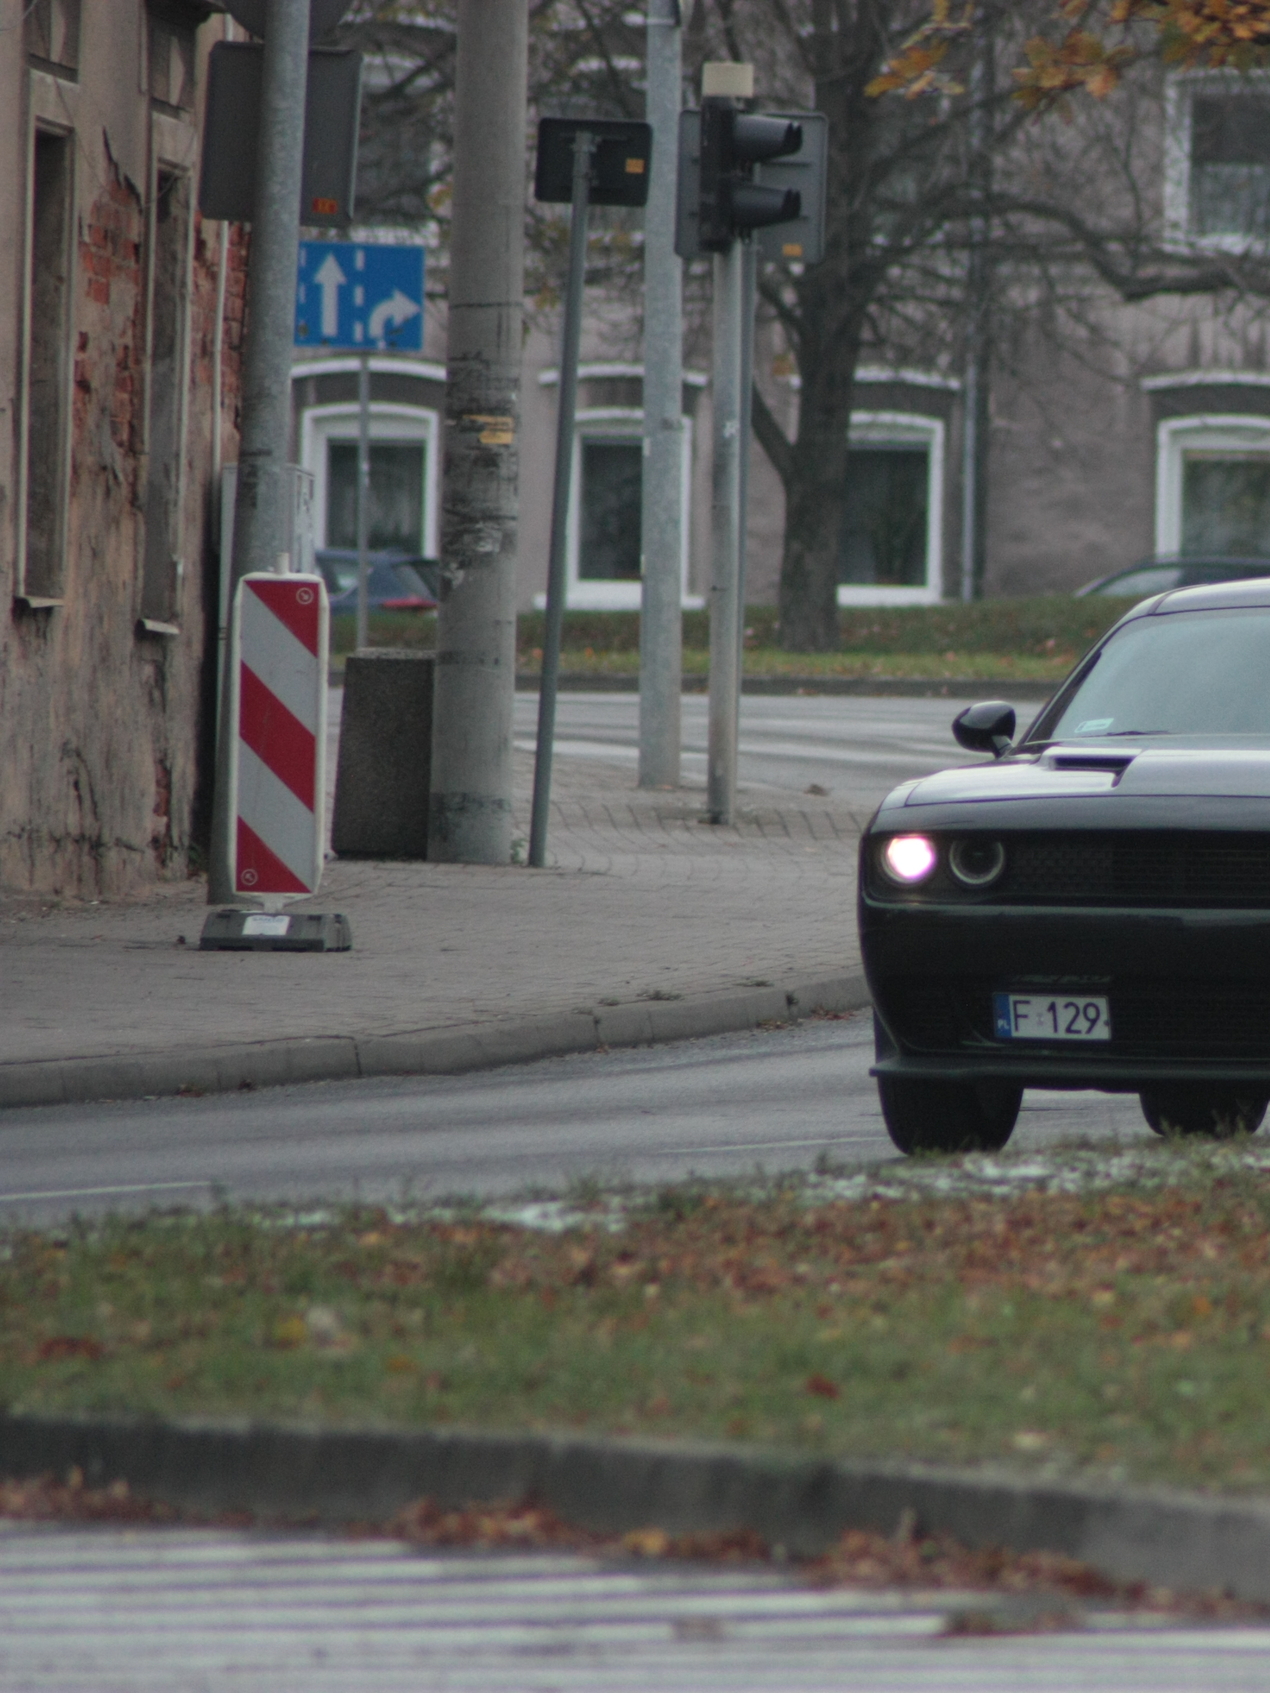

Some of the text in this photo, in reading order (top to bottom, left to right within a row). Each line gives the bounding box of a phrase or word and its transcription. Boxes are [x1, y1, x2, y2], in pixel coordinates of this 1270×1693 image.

[997, 1018, 1010, 1030] PL
[1012, 1000, 1101, 1035] F 129
